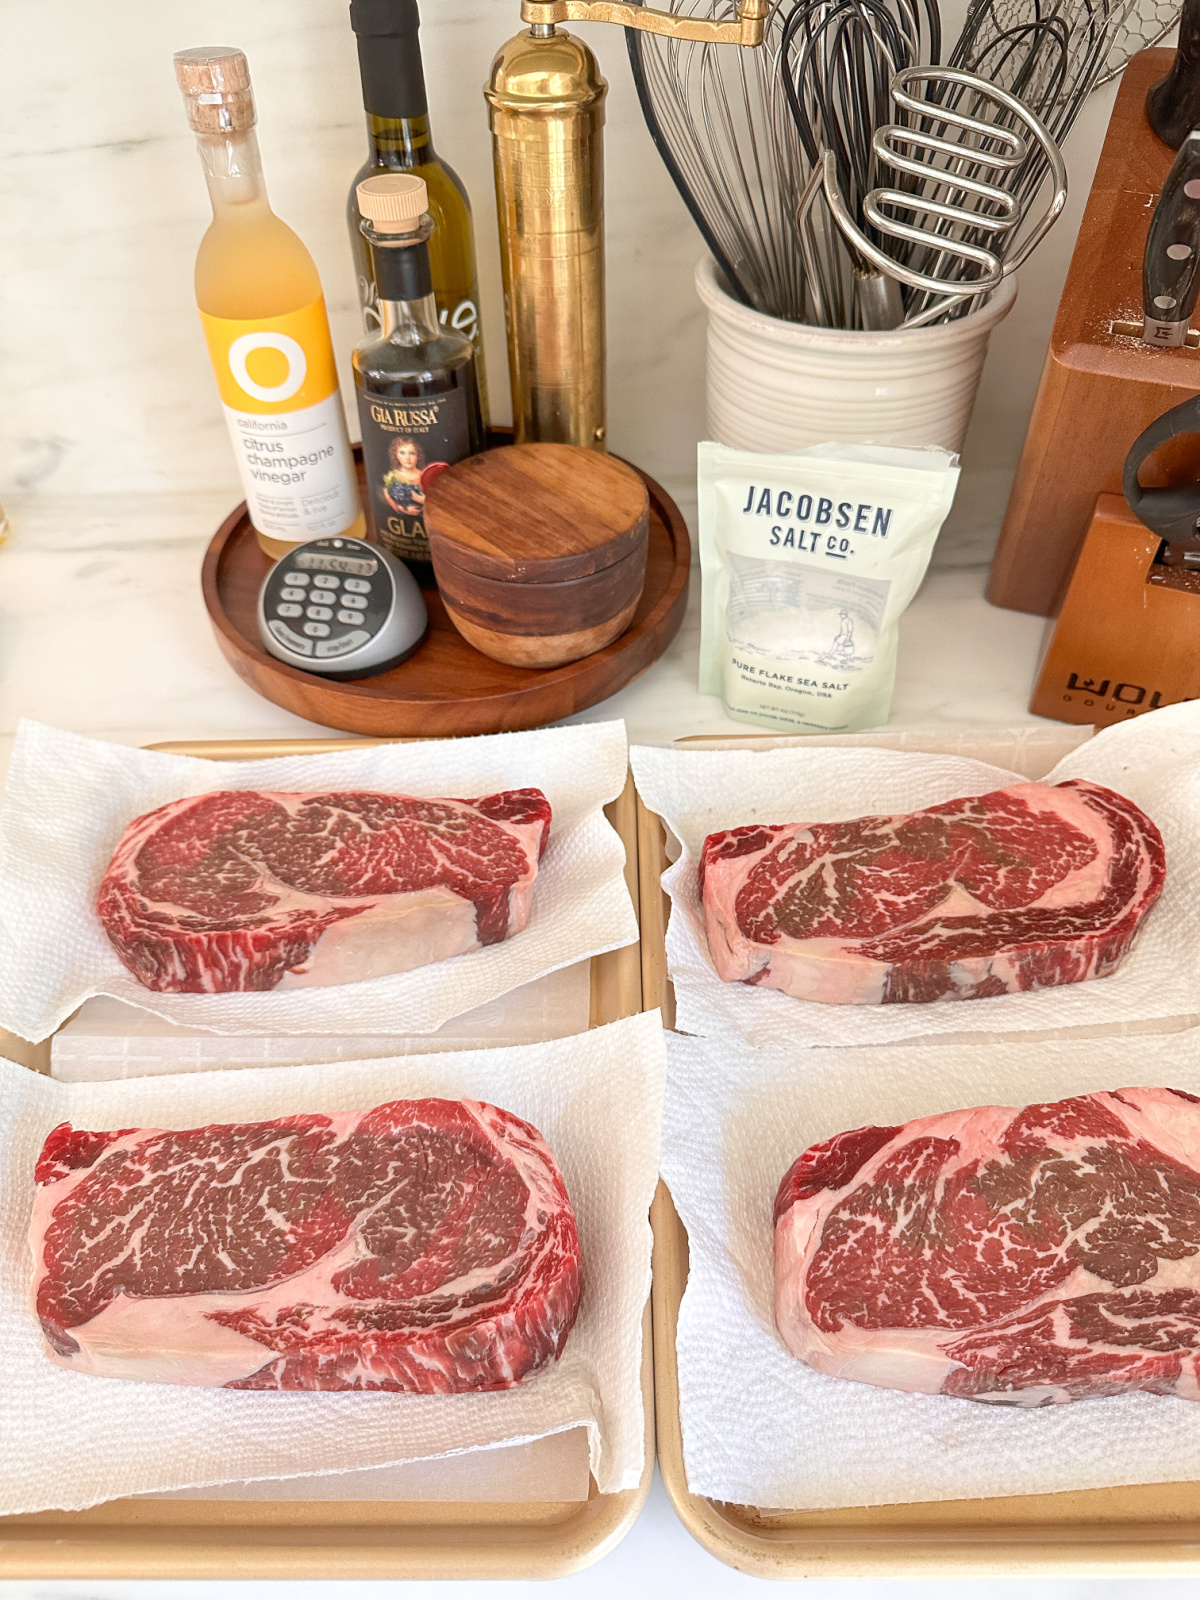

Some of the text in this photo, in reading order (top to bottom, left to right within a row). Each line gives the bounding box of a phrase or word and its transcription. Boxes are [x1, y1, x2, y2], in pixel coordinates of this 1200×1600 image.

[229, 332, 307, 402] O
[237, 418, 288, 431] california
[370, 404, 393, 425] GIA
[380, 424, 403, 434] PRODUCT
[413, 426, 430, 434] ITALY
[243, 438, 284, 452] citrus
[247, 445, 335, 469] champagne
[250, 469, 307, 485] vinegar
[742, 485, 893, 538] JACOBSEN
[387, 516, 428, 539] GLA
[769, 525, 823, 554] SALT
[731, 657, 849, 691] PURE FLAKE SEA SALT
[816, 691, 832, 699] USA
[1065, 672, 1193, 710] WOL
[1062, 693, 1136, 716] GOUR
